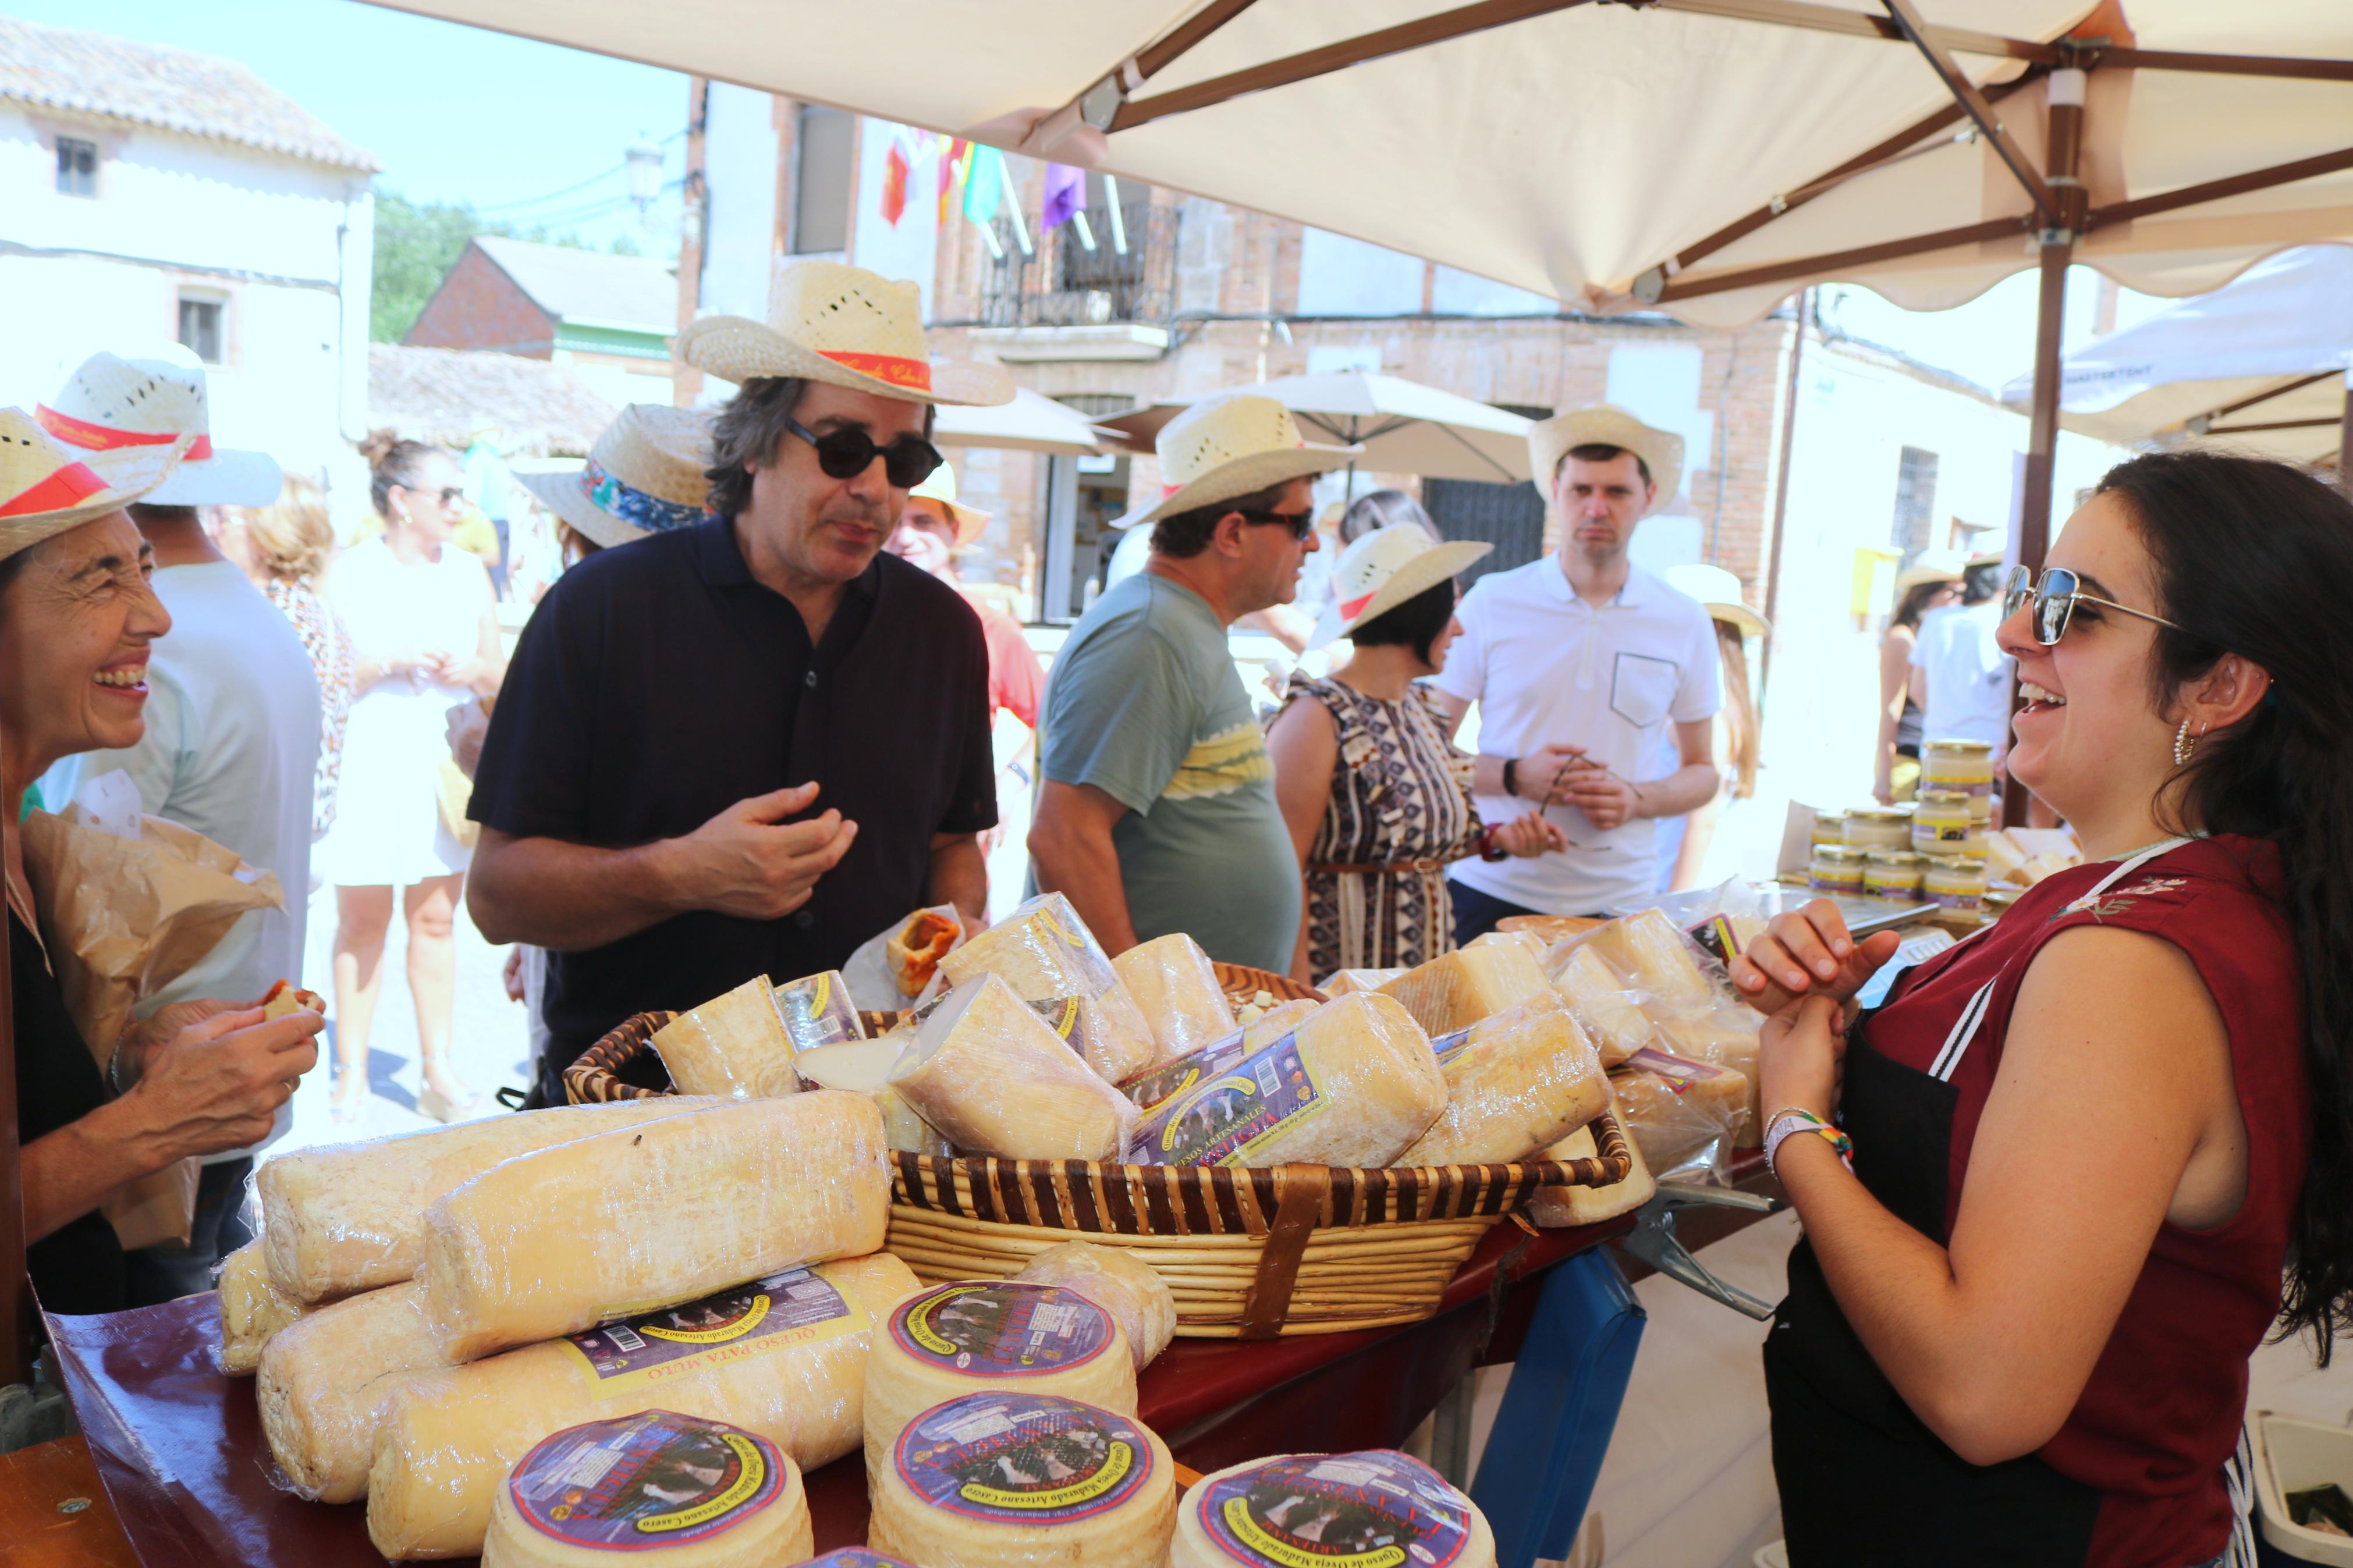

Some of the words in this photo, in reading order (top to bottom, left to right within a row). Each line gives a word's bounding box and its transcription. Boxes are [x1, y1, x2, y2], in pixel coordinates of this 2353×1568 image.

[1164, 1129, 1173, 1150] Queso
[1237, 1079, 1253, 1093] Casero
[1176, 1146, 1203, 1165] UESOS
[1204, 1105, 1268, 1150] ARTESANALES
[756, 1296, 767, 1309] Queso
[743, 1314, 760, 1327] Oveja
[643, 1326, 669, 1336] Casero
[670, 1331, 704, 1341] Artesano
[707, 1324, 746, 1340] Madurado
[914, 1322, 926, 1336] Oveja
[757, 1327, 816, 1350] QUESO
[929, 1340, 952, 1353] Queso
[707, 1345, 752, 1363] PATA
[647, 1359, 702, 1379] MULO
[728, 1435, 749, 1451] Queso
[1113, 1445, 1127, 1462] Queso
[1112, 1461, 1126, 1469] de
[1097, 1469, 1120, 1484] Oveja
[966, 1487, 998, 1503] Casero
[1000, 1494, 1048, 1505] Artesano
[1050, 1483, 1100, 1503] Madurado
[684, 1500, 728, 1521] Artesano
[642, 1516, 683, 1528] Casero
[1261, 1541, 1312, 1567] Madurado
[1367, 1549, 1401, 1565] Queso
[1351, 1559, 1364, 1568] de
